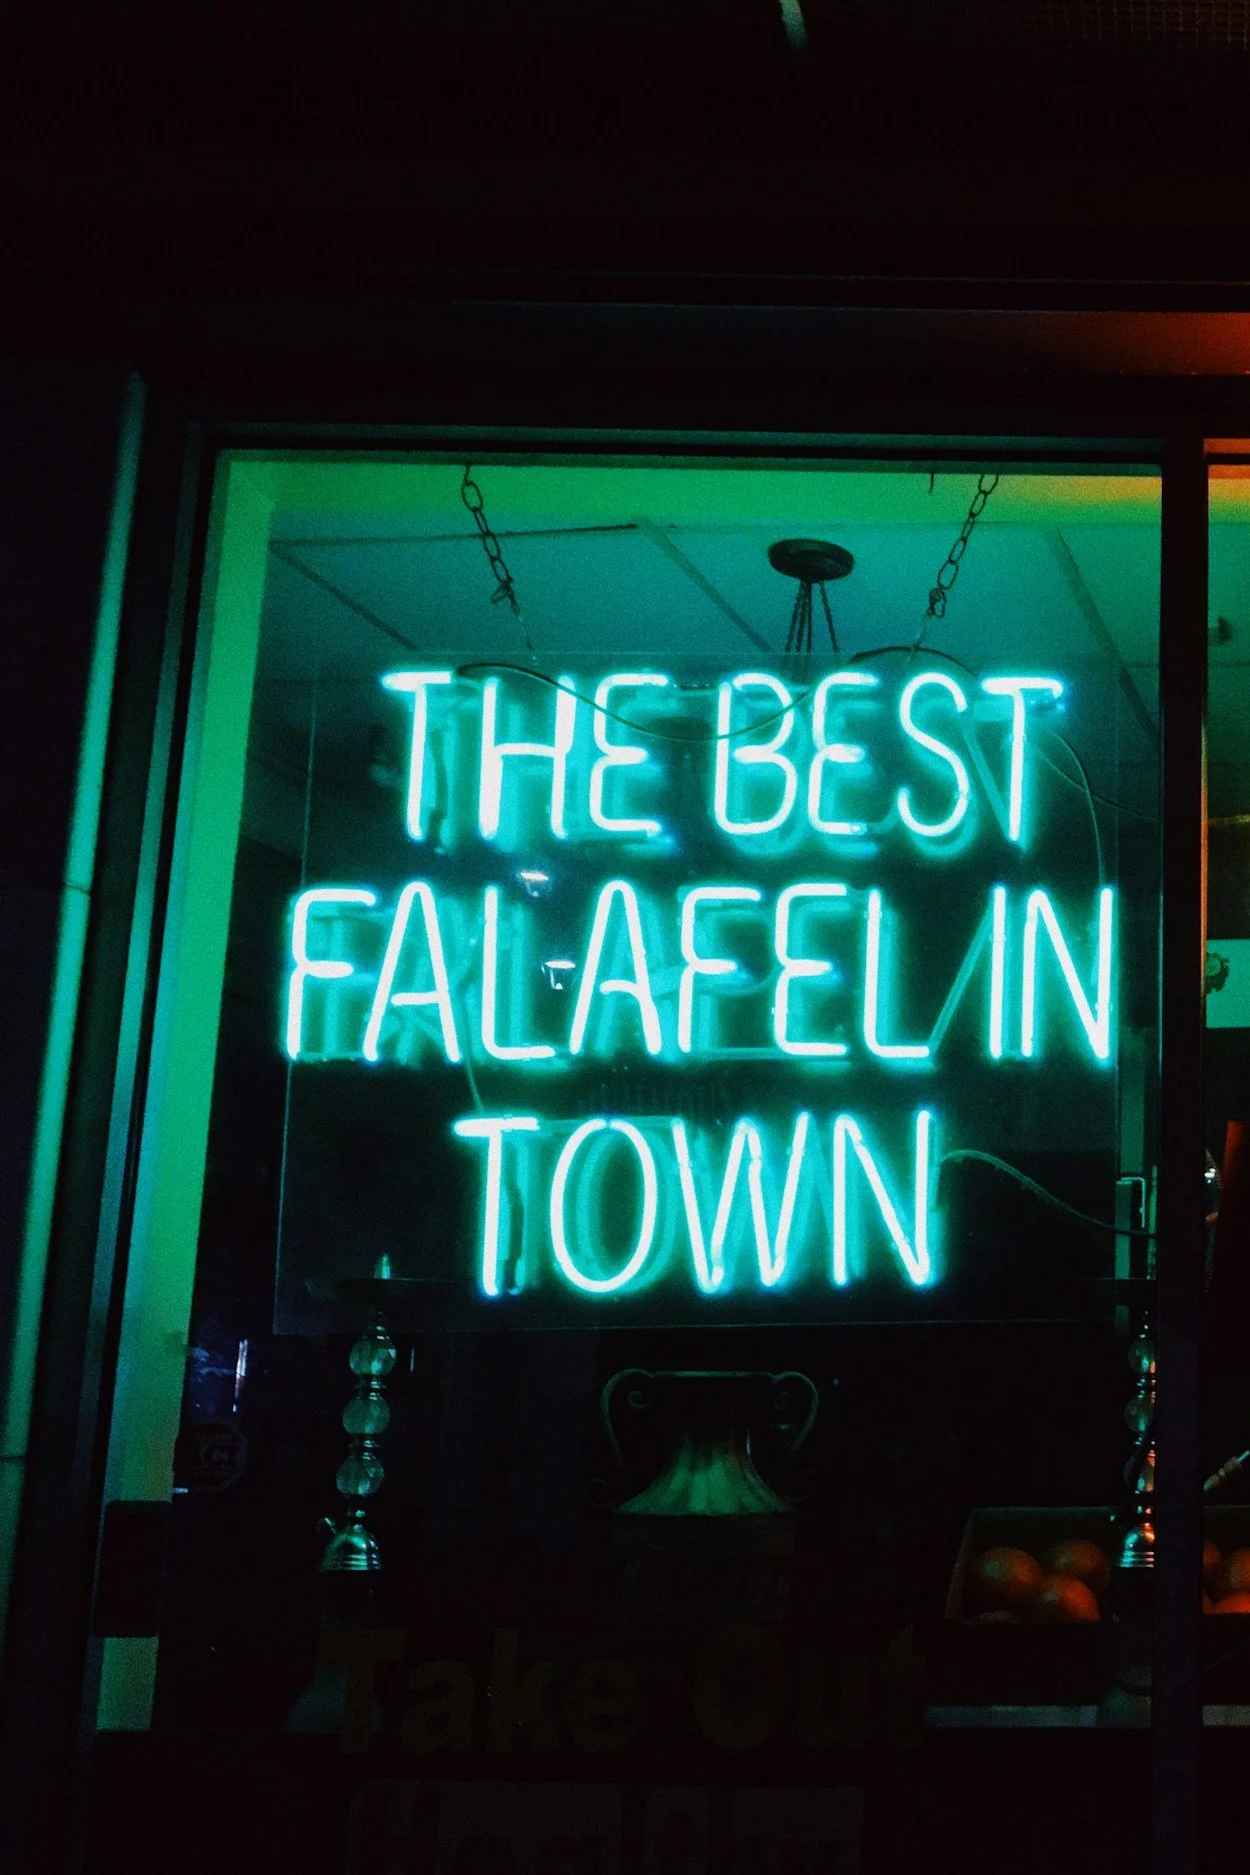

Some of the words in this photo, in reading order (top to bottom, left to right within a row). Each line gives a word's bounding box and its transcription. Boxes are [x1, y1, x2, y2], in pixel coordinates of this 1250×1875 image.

[383, 670, 671, 842] THE
[709, 670, 1065, 842] BEST
[284, 880, 930, 1062] FALAFEL
[988, 884, 1116, 1062] IN
[452, 1110, 933, 1296] TOWN
[317, 1625, 643, 1757] Take
[693, 1620, 929, 1753] Out
